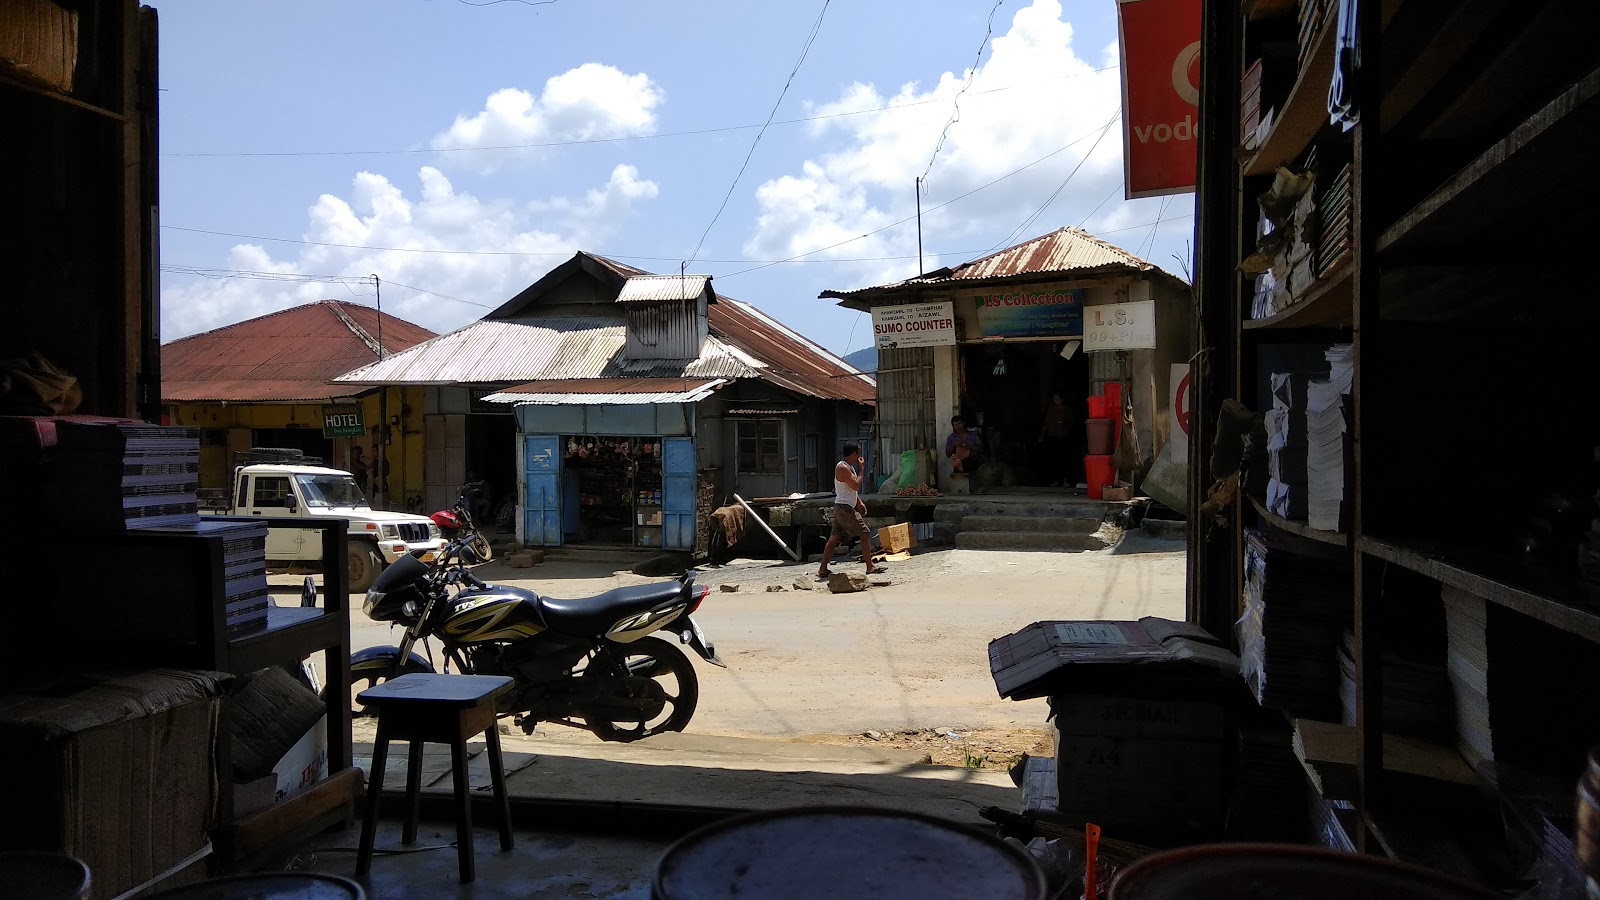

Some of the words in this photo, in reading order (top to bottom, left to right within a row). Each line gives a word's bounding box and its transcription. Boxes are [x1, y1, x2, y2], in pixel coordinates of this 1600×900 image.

[1003, 291, 1074, 306] Collection
[916, 304, 943, 312] CHAMPHAI
[918, 311, 942, 319] AIZAWL
[875, 322, 903, 334] SUMO
[905, 318, 953, 332] COUNTER
[325, 414, 361, 427] HOTEL
[454, 600, 476, 612] TVS
